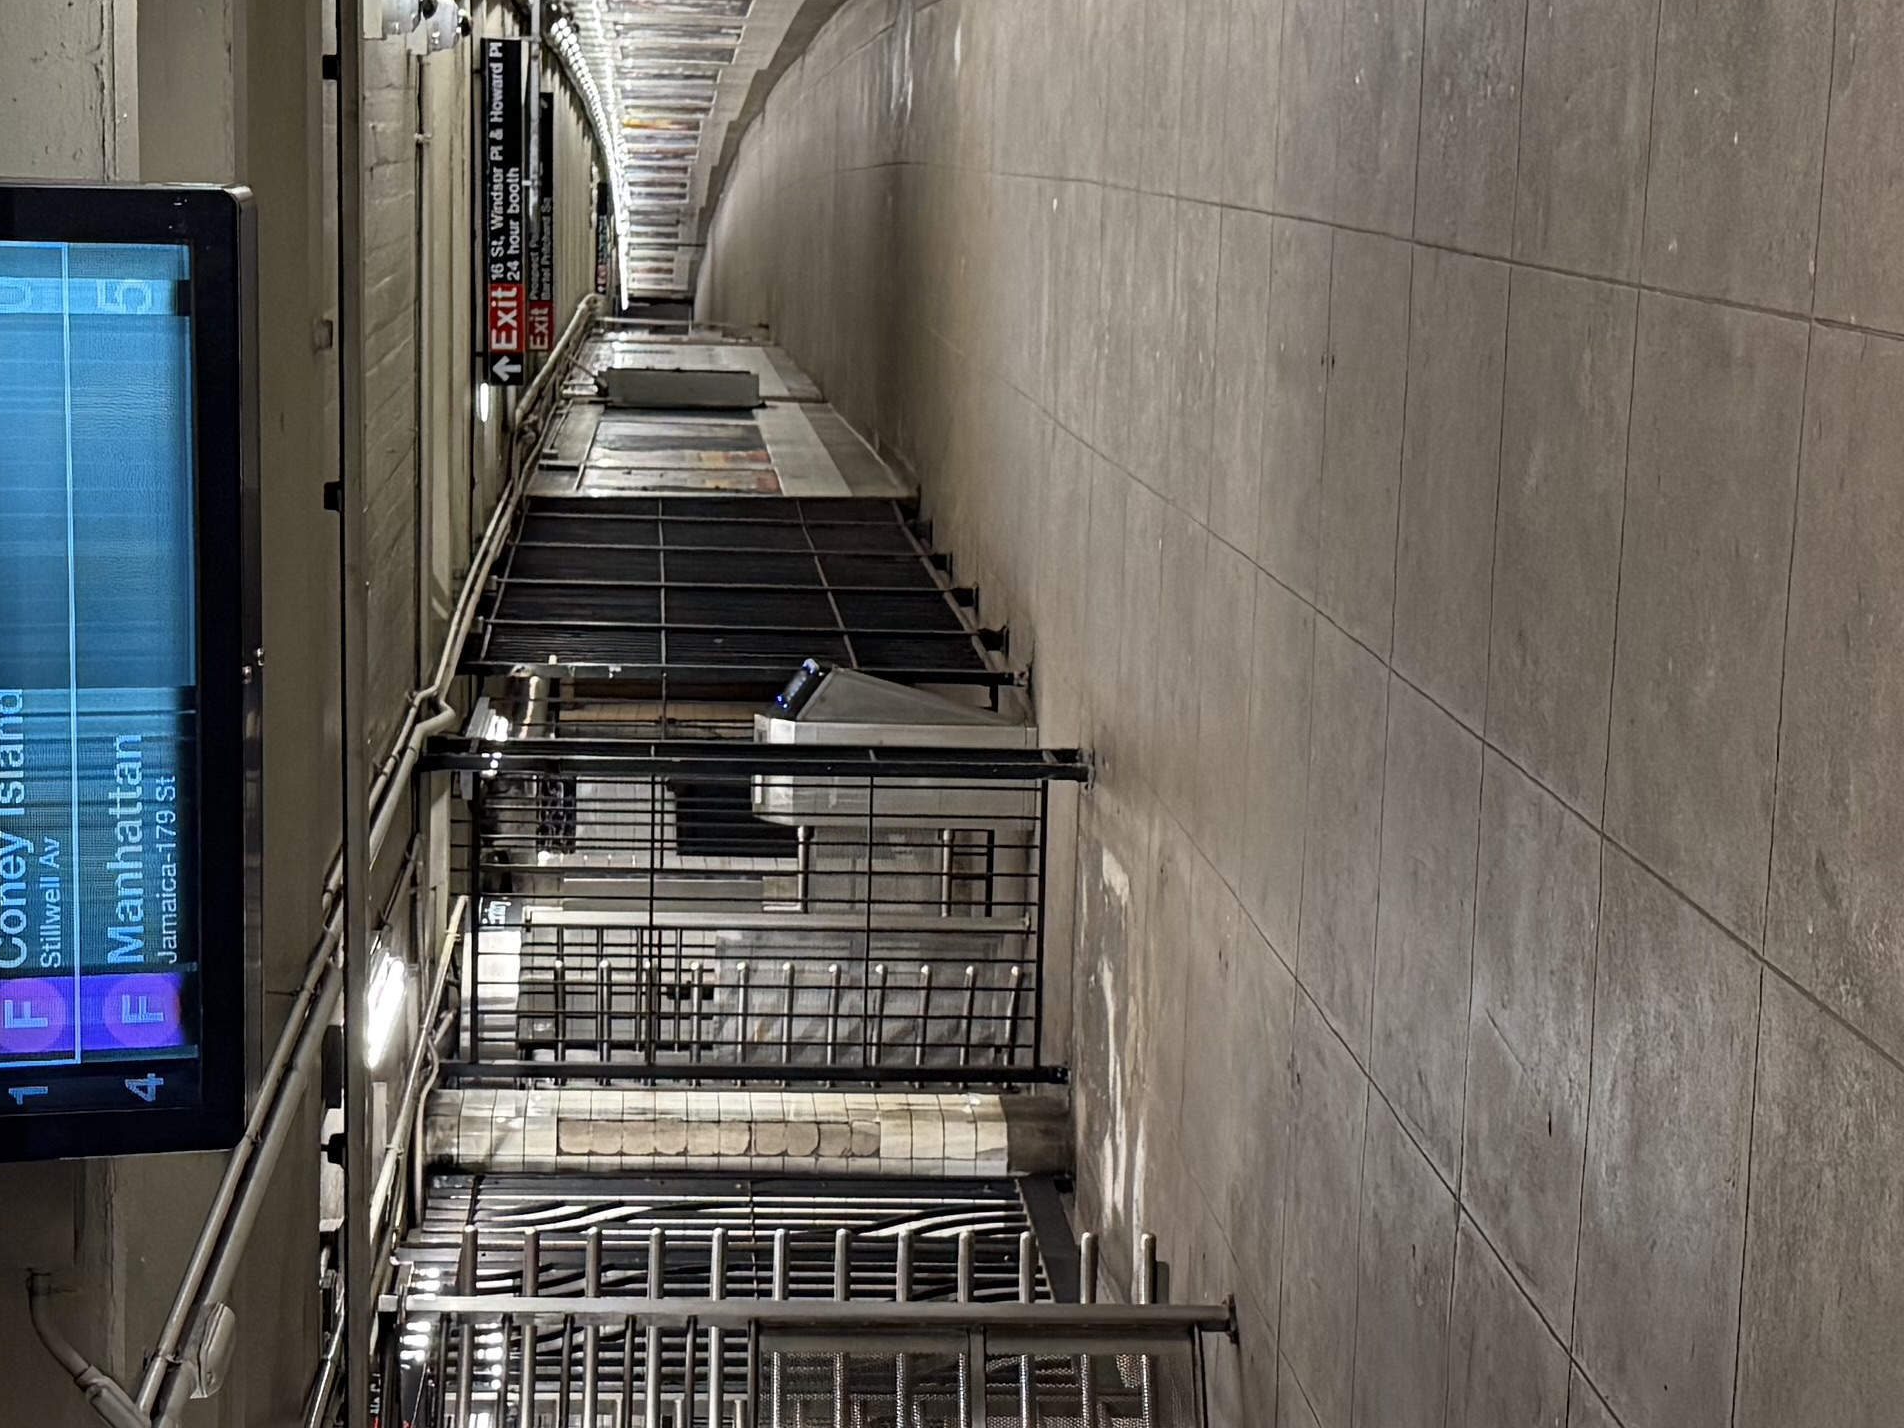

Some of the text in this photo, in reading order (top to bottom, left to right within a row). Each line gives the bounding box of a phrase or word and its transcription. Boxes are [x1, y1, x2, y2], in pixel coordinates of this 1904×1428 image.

[489, 41, 506, 281] 16 St, Windsor Pl & Howard Pl
[506, 166, 521, 282] 24 hour booth
[490, 286, 518, 350] Exit
[529, 306, 550, 351] Exit
[106, 734, 146, 965] Manhattan
[156, 775, 178, 965] Jamaica-179 St
[39, 836, 62, 970] Stillwell Av
[4, 999, 49, 1029] F
[121, 994, 165, 1024] F
[8, 1085, 49, 1105] 1
[124, 1072, 165, 1103] 4
